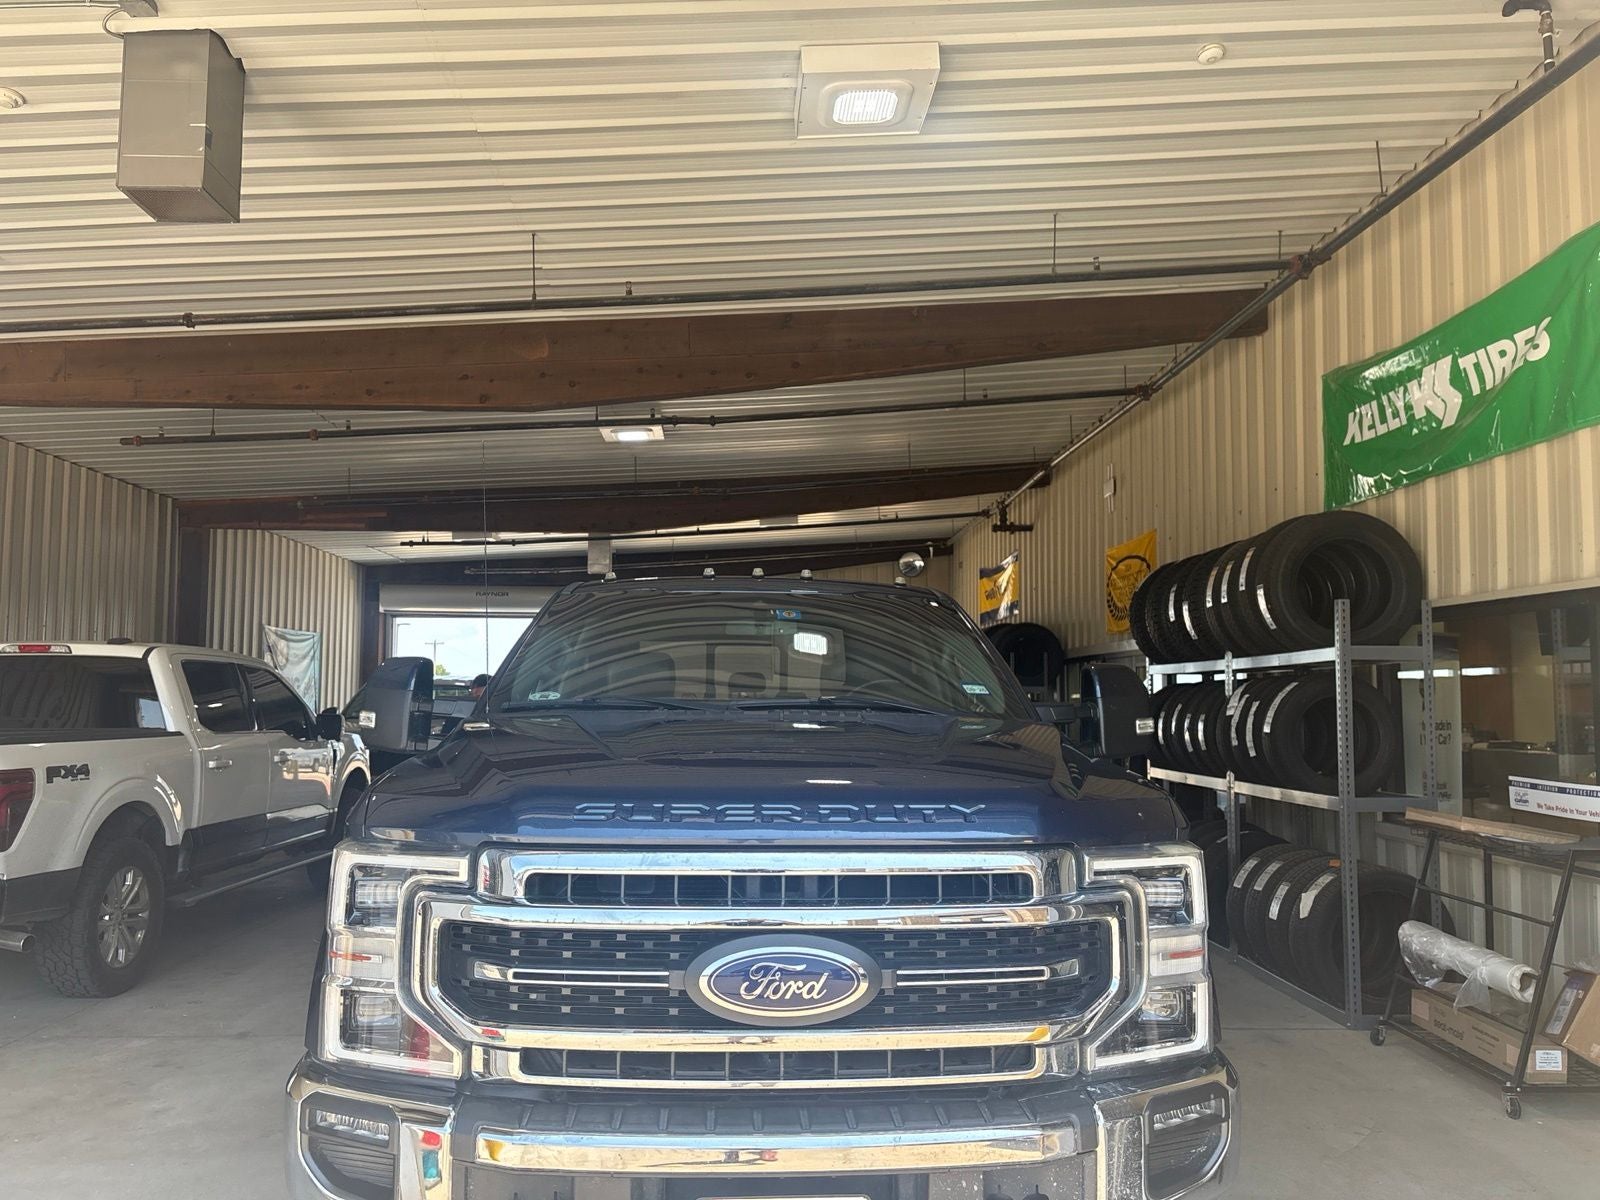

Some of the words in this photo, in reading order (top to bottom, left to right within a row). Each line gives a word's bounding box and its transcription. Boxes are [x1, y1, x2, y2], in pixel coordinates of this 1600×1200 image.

[1343, 385, 1408, 446] KELLY
[1458, 316, 1552, 397] TIRES
[46, 763, 90, 784] FX4
[572, 802, 802, 823] SUPER
[817, 802, 987, 823] DUTY
[739, 961, 829, 1001] Ford
